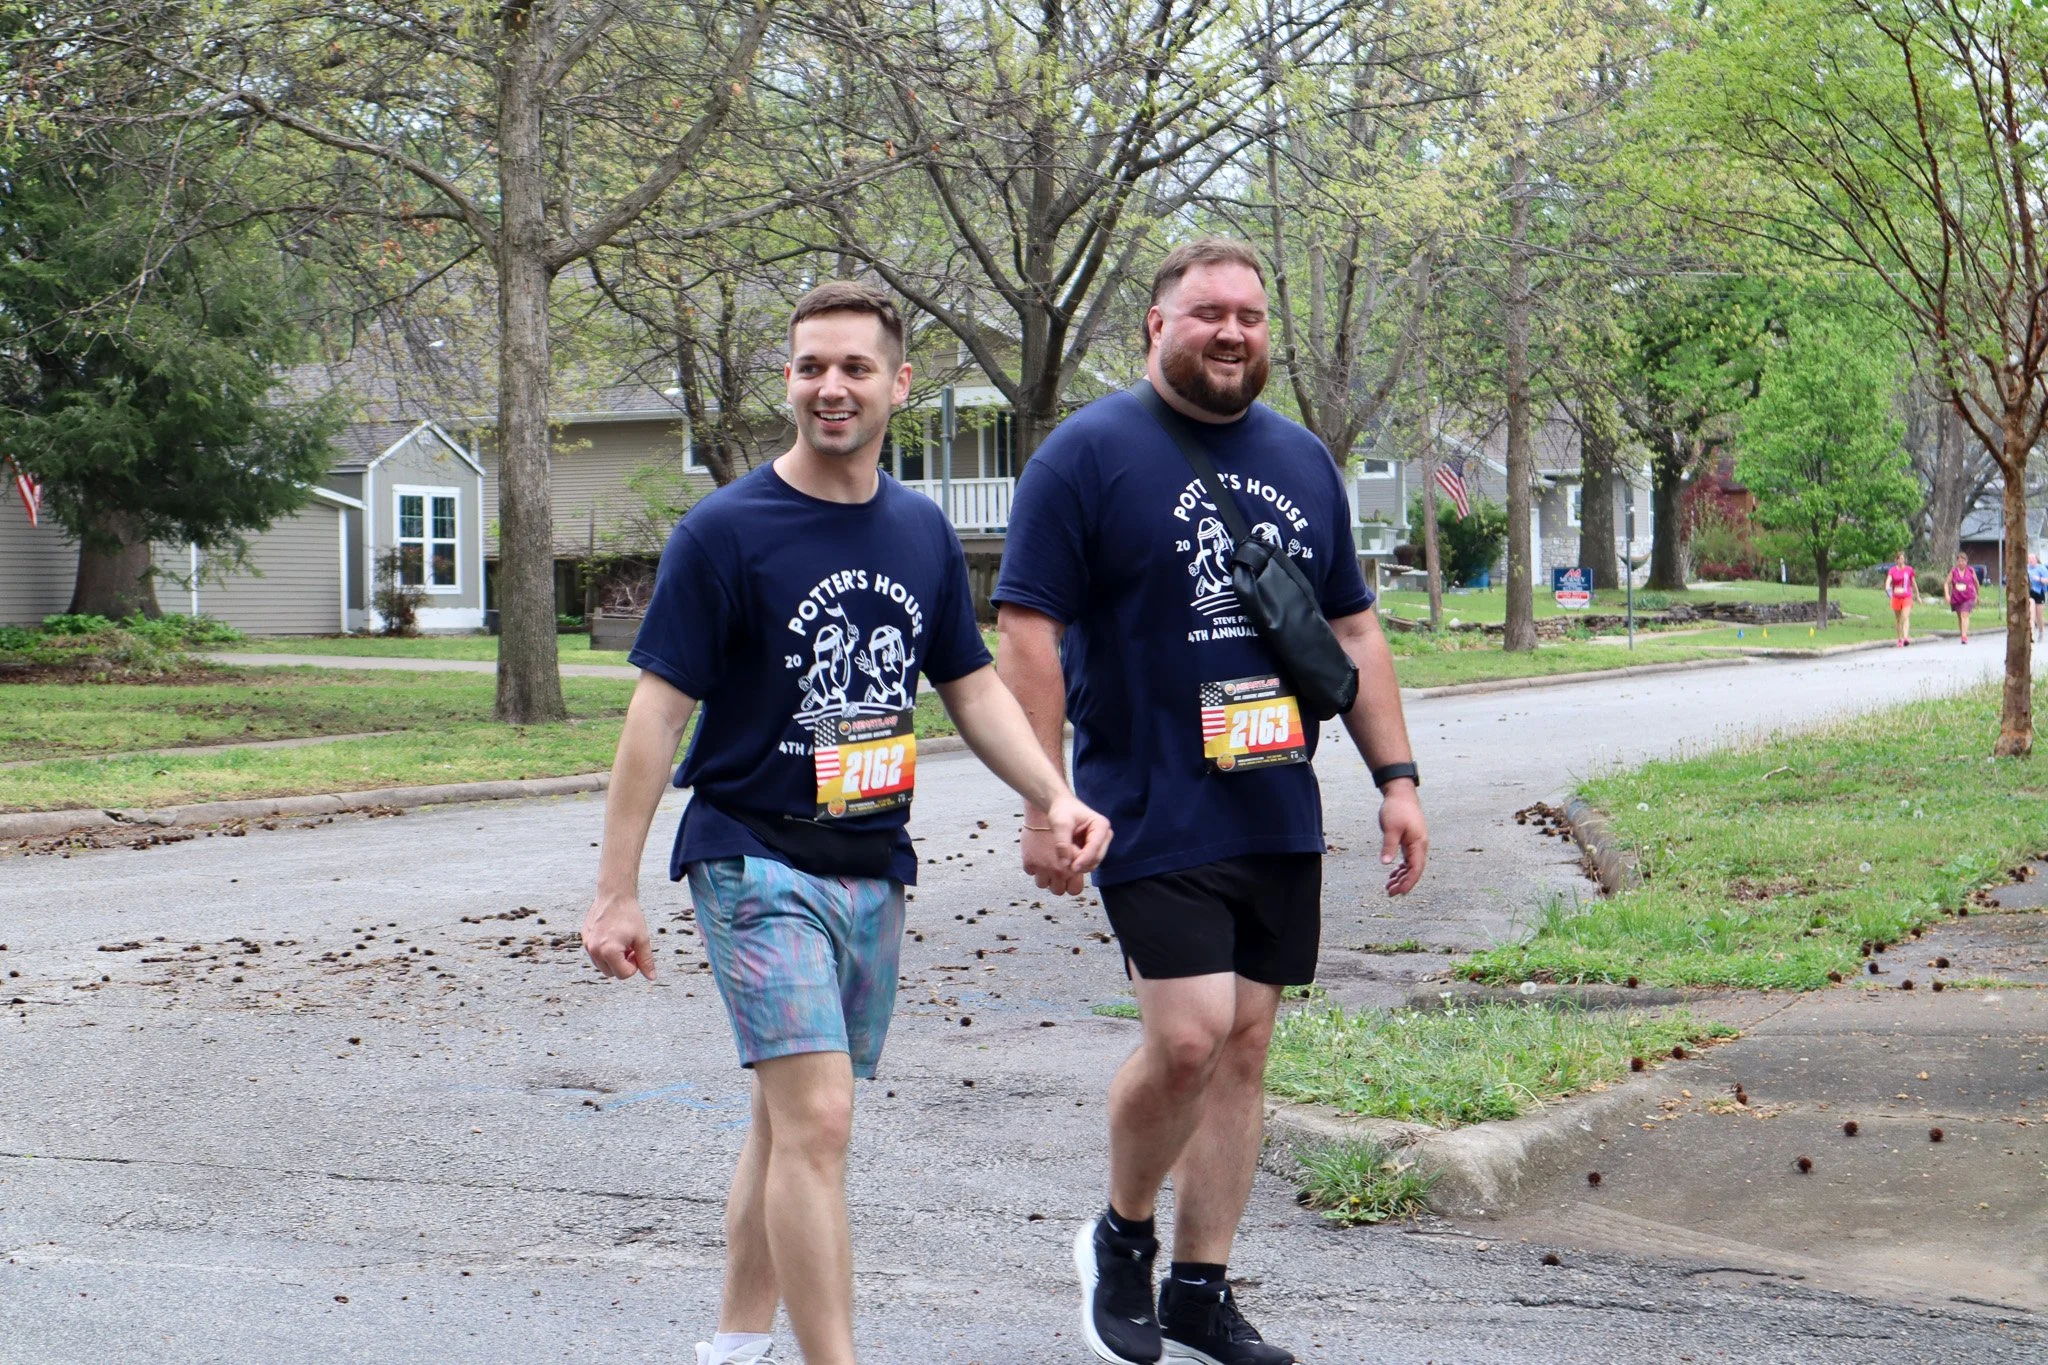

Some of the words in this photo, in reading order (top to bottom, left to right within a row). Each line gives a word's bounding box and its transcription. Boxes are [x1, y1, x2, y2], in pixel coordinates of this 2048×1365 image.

[1247, 478, 1308, 532] HOUSE
[1175, 539, 1191, 552] 20
[1302, 546, 1313, 559] 26
[788, 569, 868, 637] POTTER'S
[874, 573, 922, 638] HOUSE
[1213, 616, 1237, 626] STEVE
[1187, 629, 1209, 643] 4TH
[1211, 626, 1258, 640] ANNUAL
[784, 654, 802, 668] 20
[1229, 704, 1289, 748] 2163
[778, 741, 805, 756] 4TH
[842, 744, 904, 793] 2162
